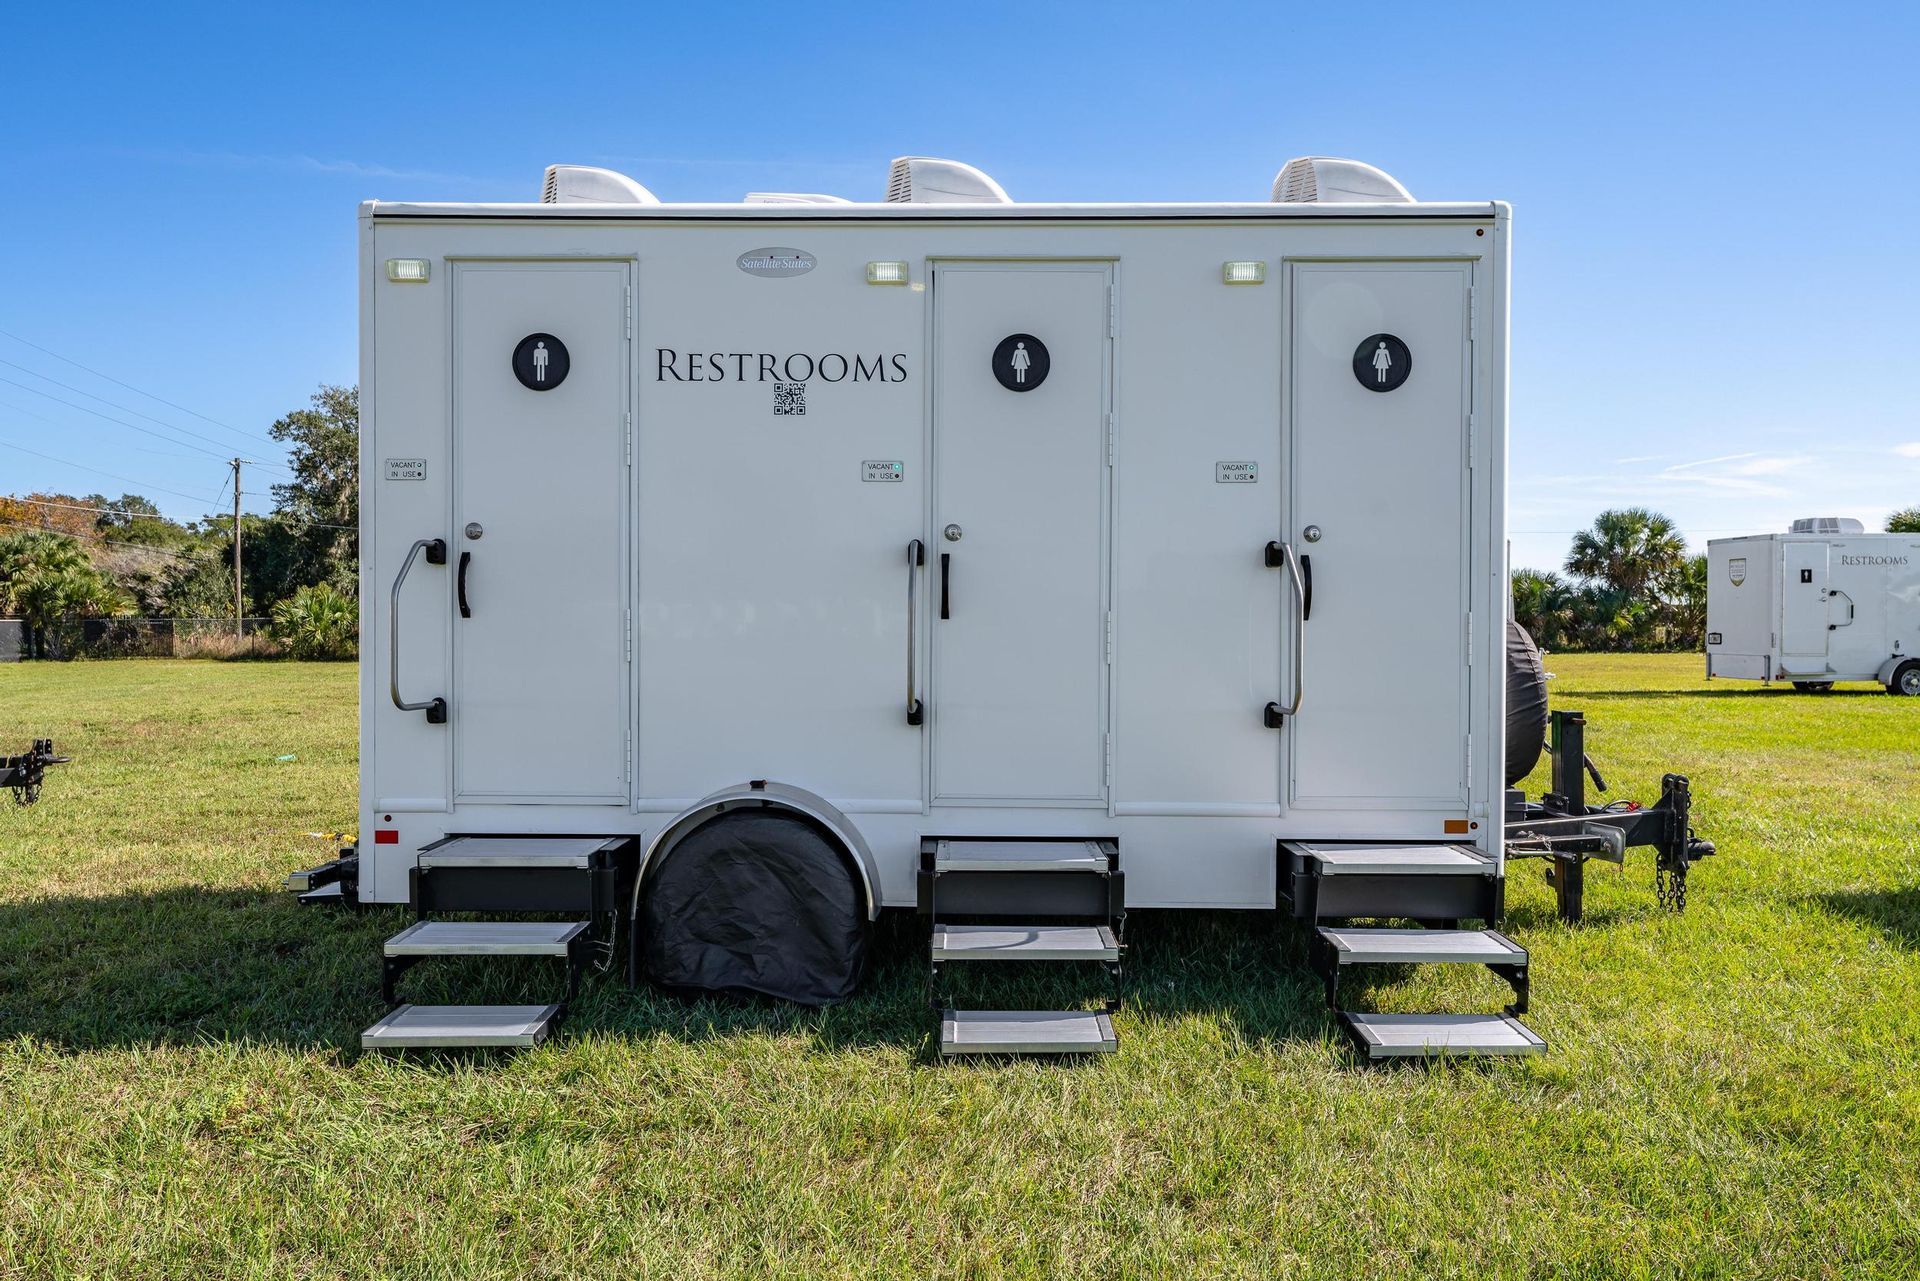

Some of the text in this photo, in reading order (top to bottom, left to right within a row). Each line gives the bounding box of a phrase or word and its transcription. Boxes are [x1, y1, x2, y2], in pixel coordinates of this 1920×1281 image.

[741, 257, 812, 269] Satellite Suites
[656, 348, 908, 383] RESTROOMS
[402, 470, 416, 478] USE
[880, 472, 894, 480] USE
[1234, 473, 1249, 481] USE
[1841, 554, 1909, 566] RESTROOMS
